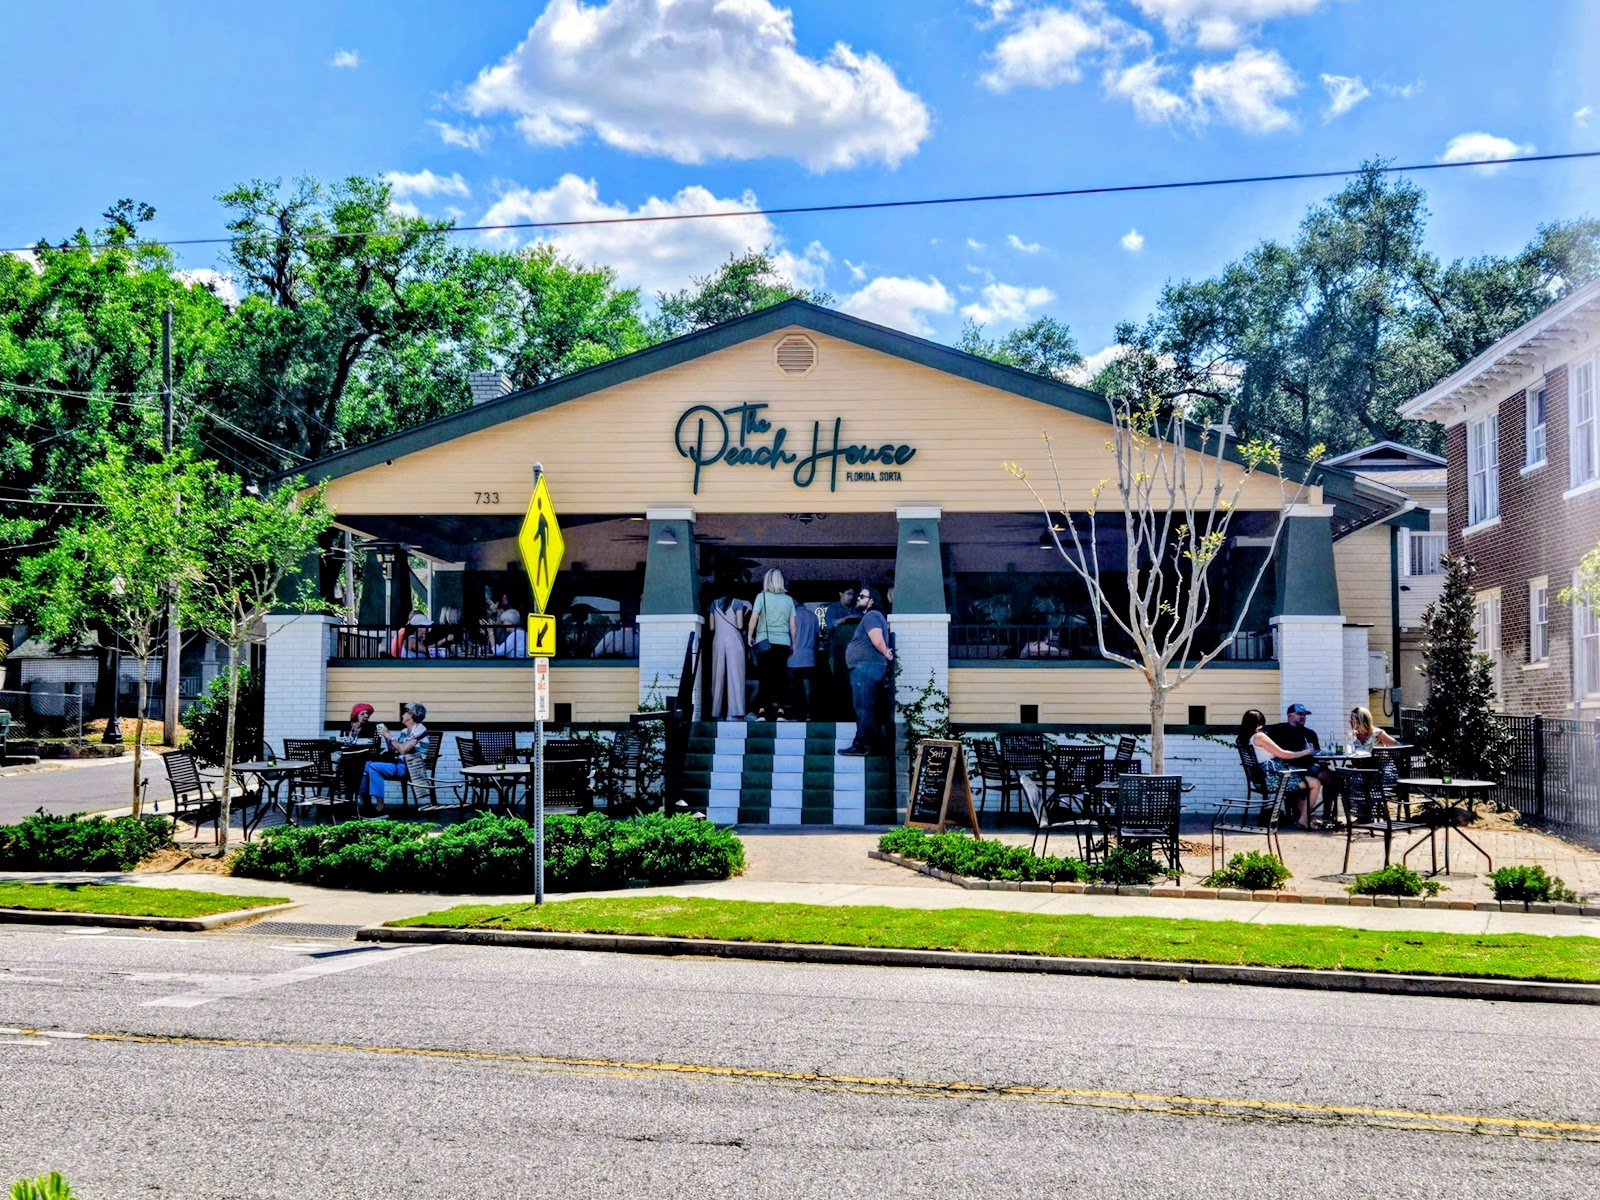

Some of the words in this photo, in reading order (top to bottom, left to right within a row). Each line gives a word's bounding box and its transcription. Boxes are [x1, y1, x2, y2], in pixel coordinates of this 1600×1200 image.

[723, 401, 772, 447] The
[675, 405, 797, 495] Peach
[793, 417, 917, 493] House
[846, 471, 877, 482] FLORIDA,
[879, 471, 902, 482] SORTA
[473, 492, 500, 504] 733
